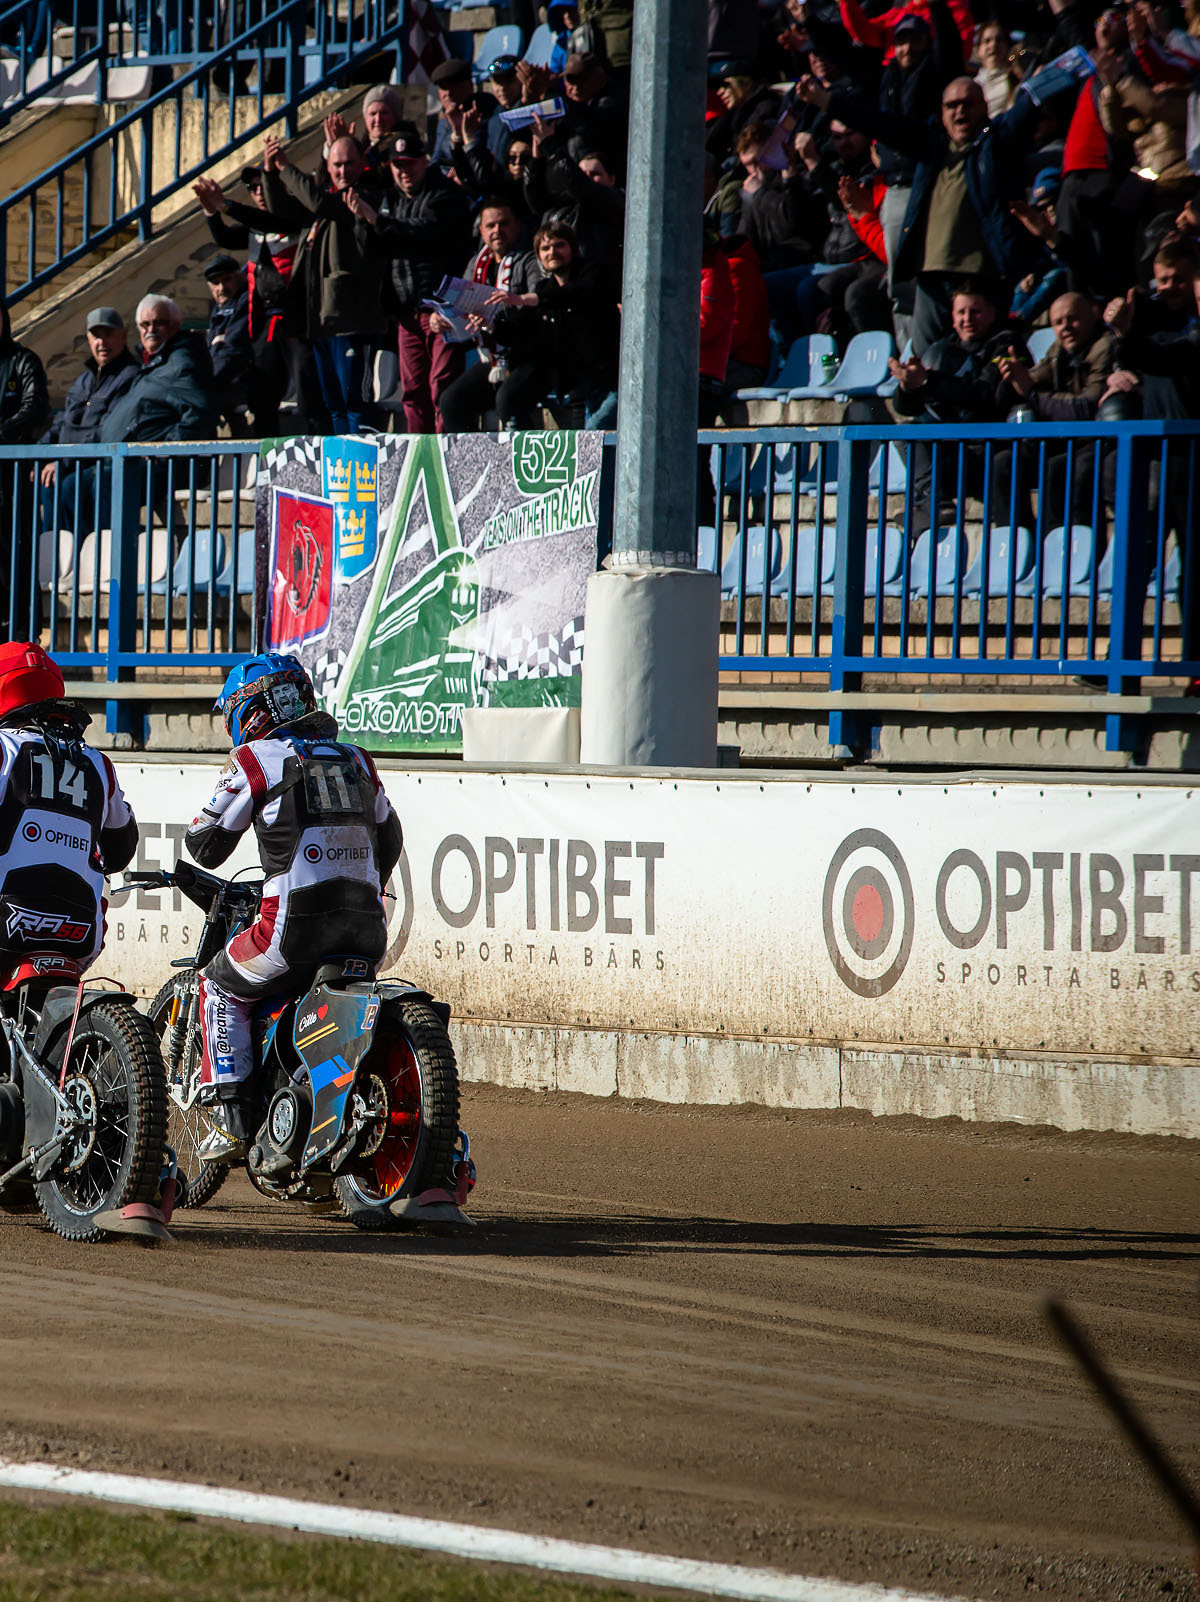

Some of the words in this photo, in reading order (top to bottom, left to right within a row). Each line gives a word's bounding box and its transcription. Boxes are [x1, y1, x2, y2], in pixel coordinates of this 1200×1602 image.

[520, 430, 569, 483] 52
[521, 500, 541, 537] THE
[543, 475, 594, 534] TRACK
[33, 753, 88, 808] 14
[309, 764, 351, 809] 11
[45, 829, 89, 852] OPTIBET
[327, 846, 370, 861] OPTIBET
[431, 833, 665, 935] OPTIBET
[936, 848, 1200, 955] OPTIBET
[117, 918, 190, 945] BĀRS
[434, 940, 559, 965] SPORTA
[584, 943, 666, 971] BĀRS
[937, 961, 1081, 988] SPORTA
[1110, 963, 1200, 993] BĀRS
